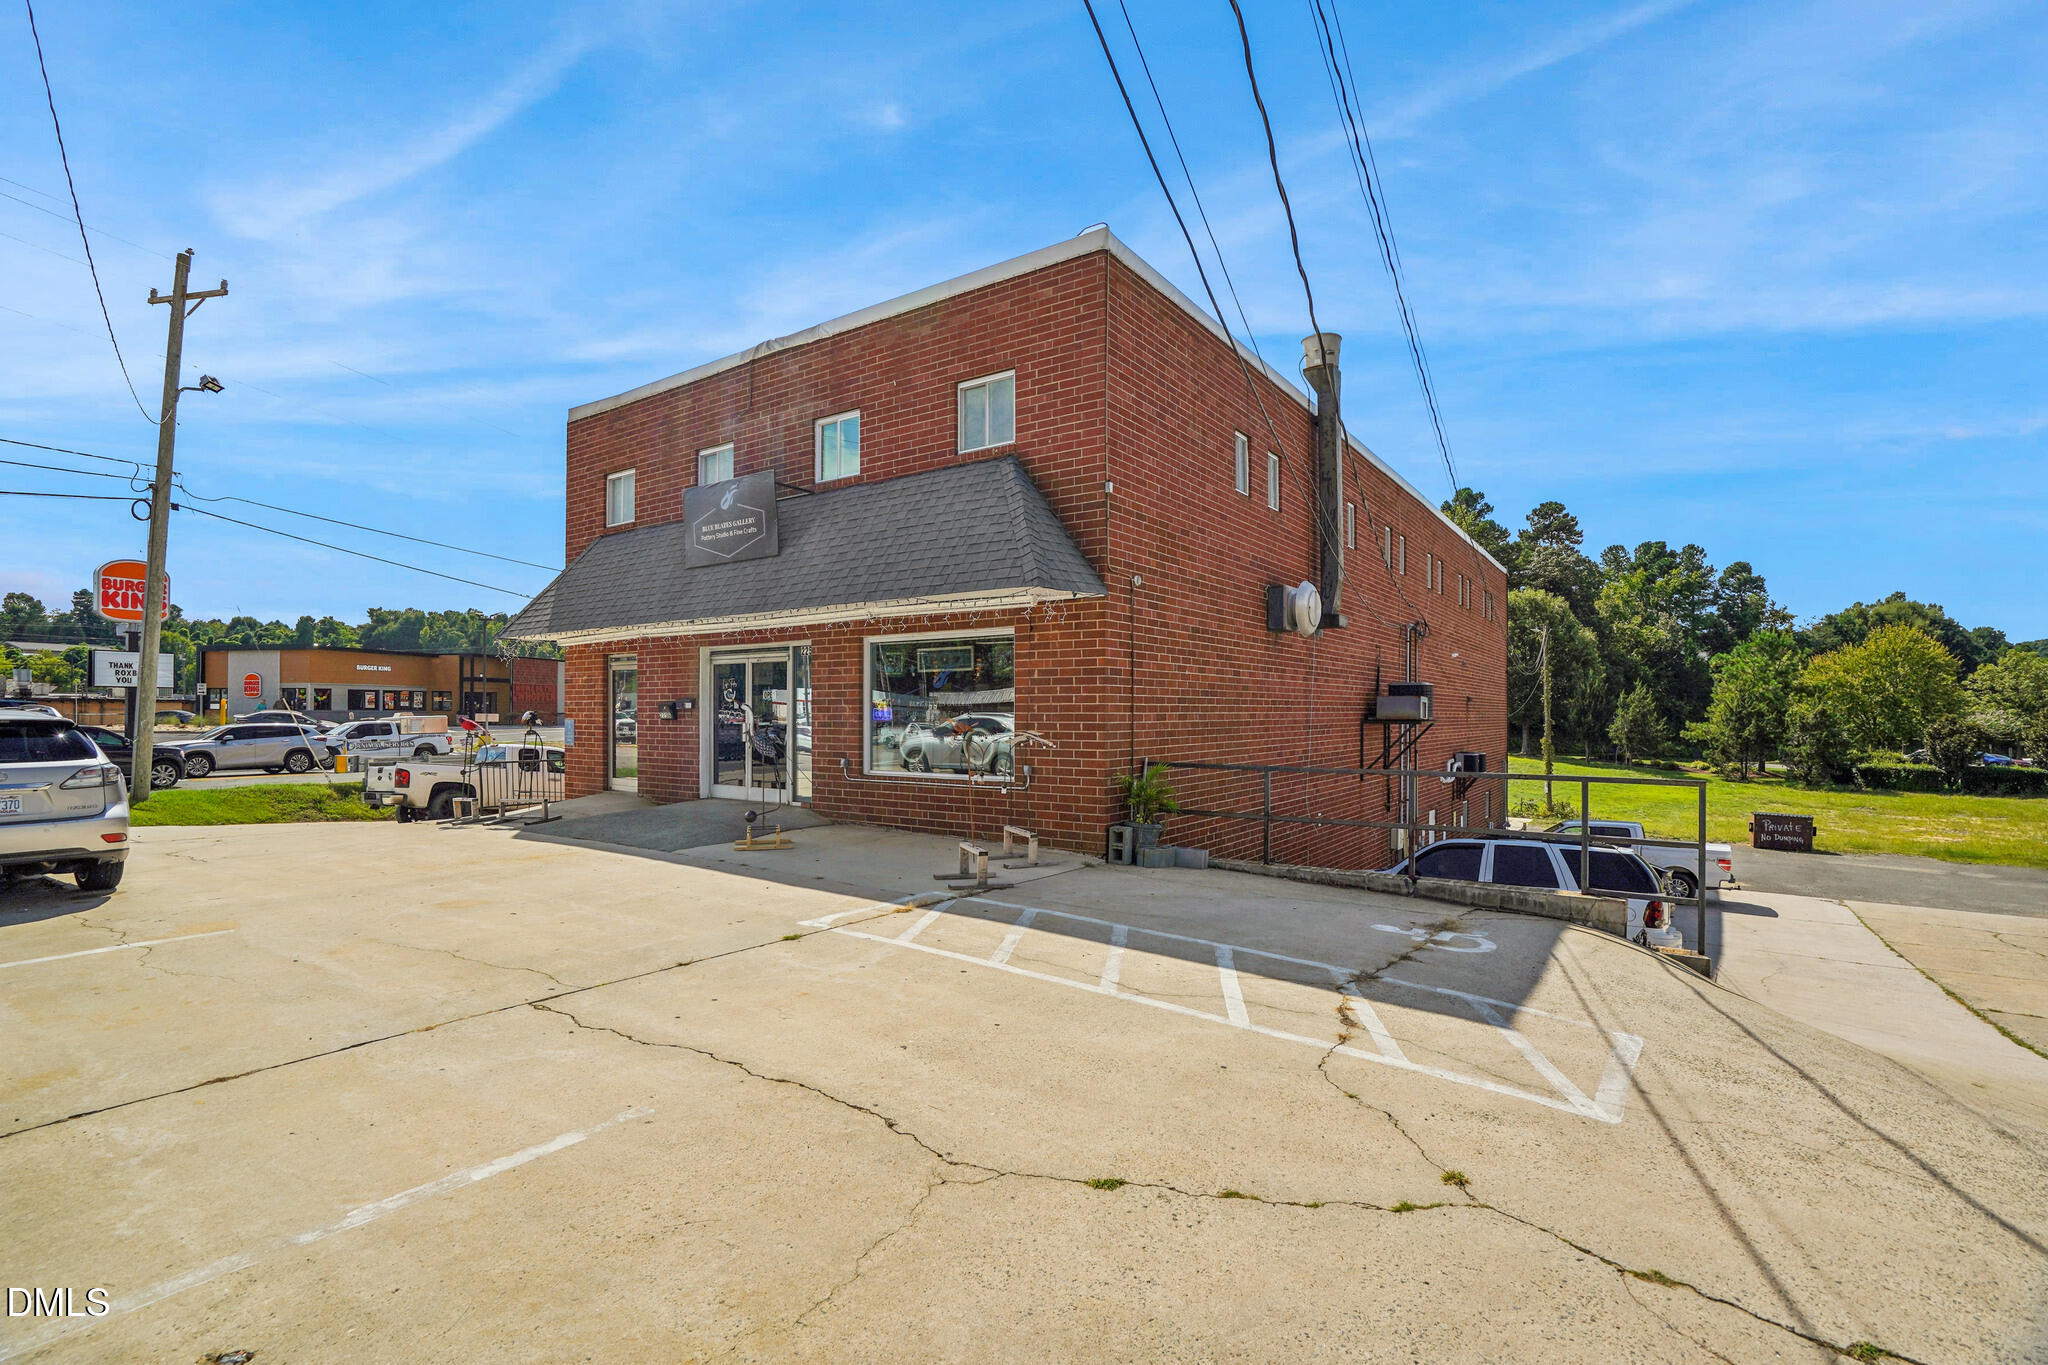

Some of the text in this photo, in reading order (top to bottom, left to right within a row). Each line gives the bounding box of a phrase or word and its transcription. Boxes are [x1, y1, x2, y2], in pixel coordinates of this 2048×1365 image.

[732, 517, 755, 526] GALLERY
[101, 577, 167, 594] BURG
[108, 661, 134, 669] THANK
[0, 799, 20, 810] 370
